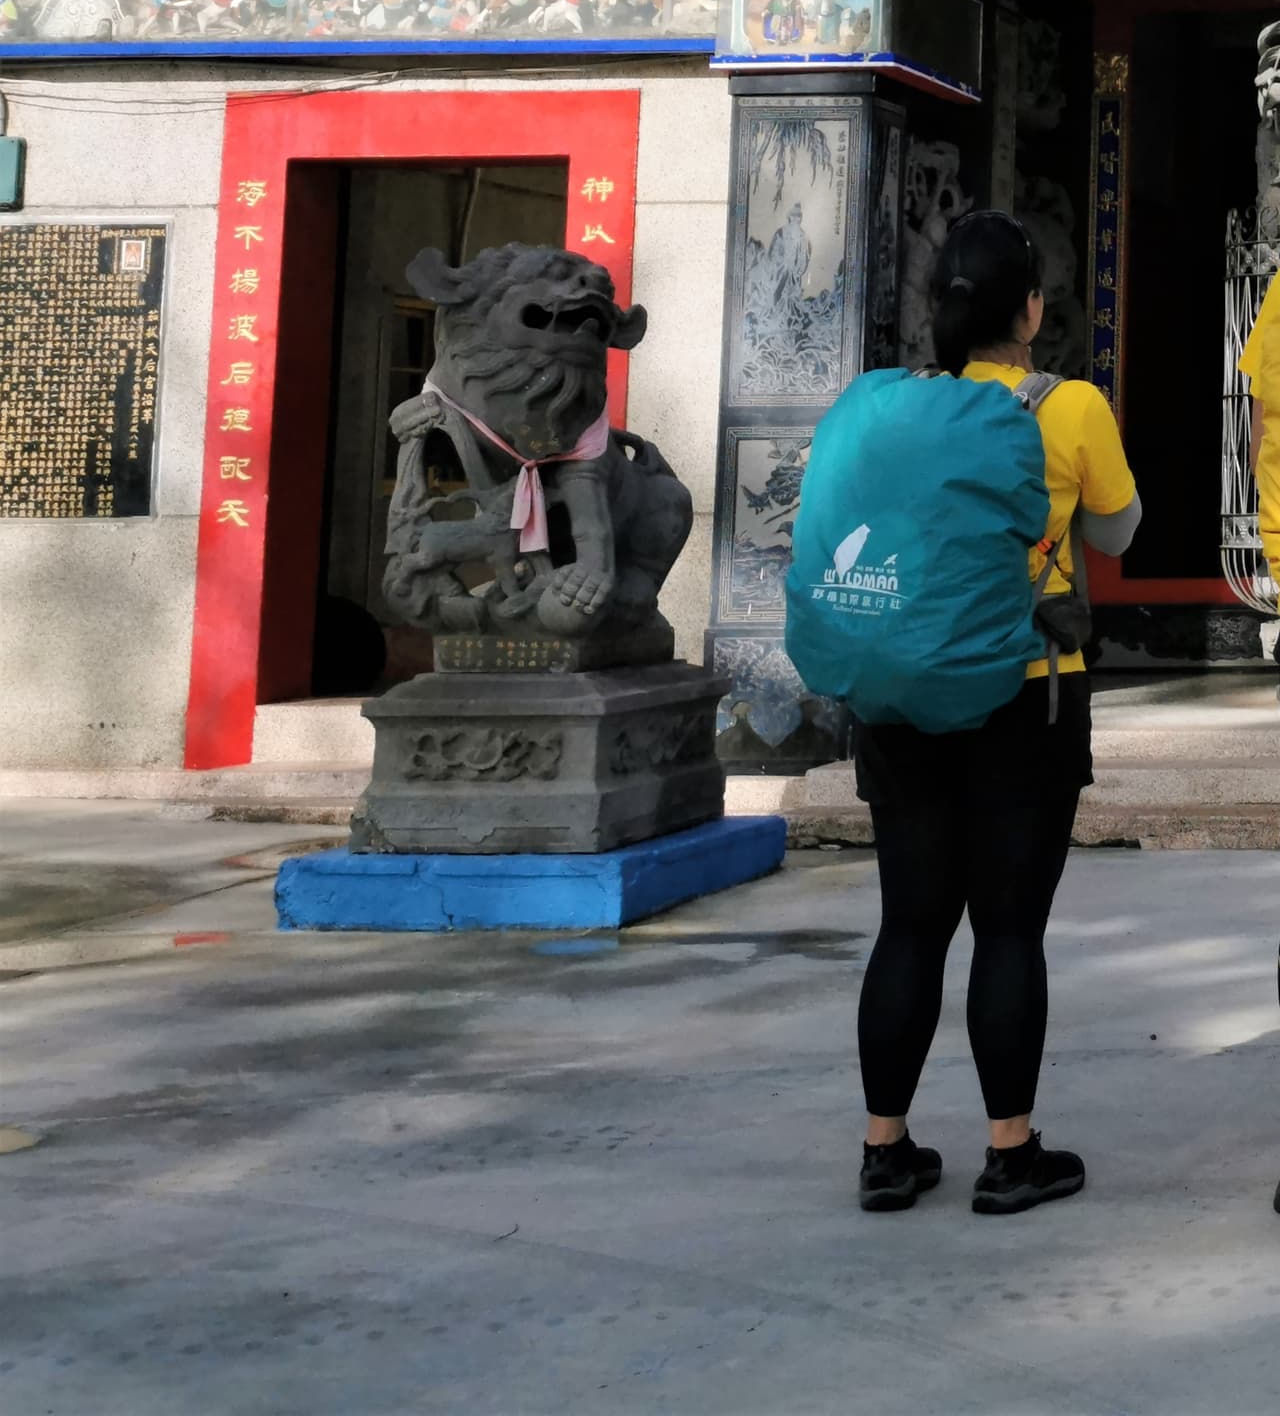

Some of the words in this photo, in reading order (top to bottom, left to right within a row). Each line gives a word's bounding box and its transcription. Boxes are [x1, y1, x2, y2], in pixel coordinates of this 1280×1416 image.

[216, 178, 268, 529] 海不揚波后德配天
